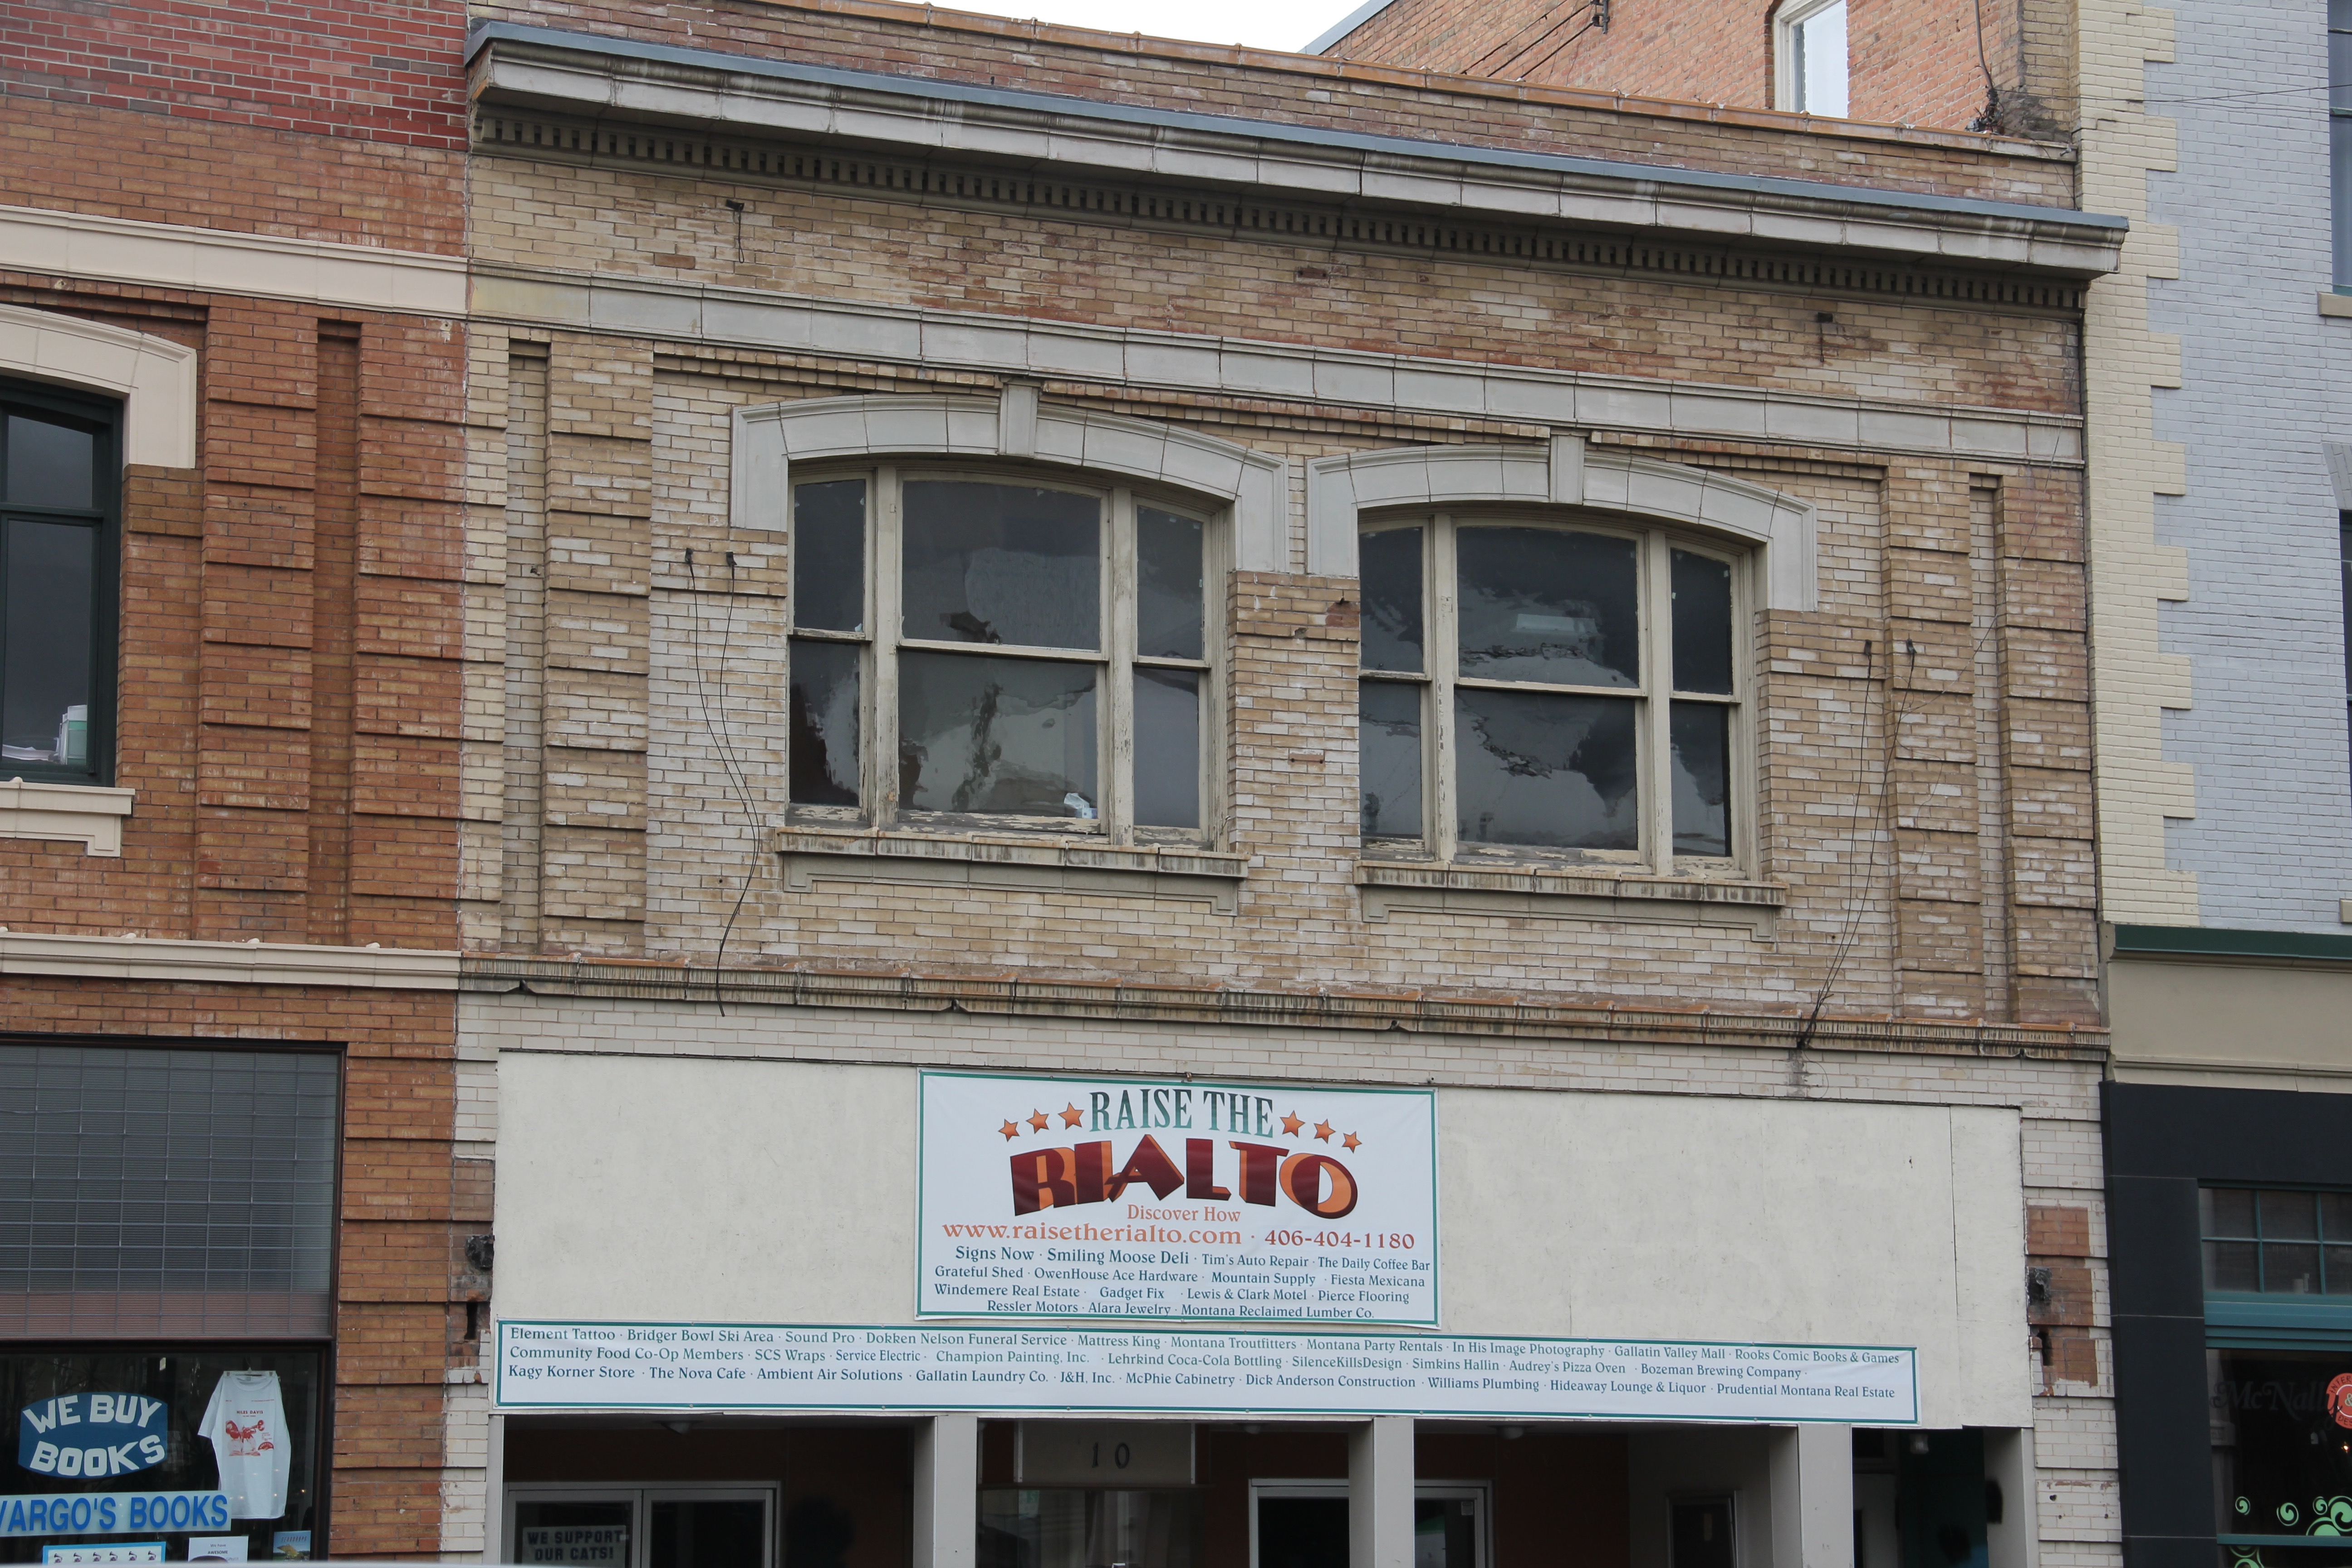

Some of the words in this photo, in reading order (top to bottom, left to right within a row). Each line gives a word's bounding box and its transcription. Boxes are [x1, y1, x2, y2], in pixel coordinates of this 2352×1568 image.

[1089, 1088, 1192, 1132] RAISE
[1204, 1091, 1273, 1138] THE
[1010, 1134, 1358, 1219] RIALTO
[1127, 1204, 1199, 1221] Discover
[1204, 1206, 1241, 1222] How
[942, 1222, 1241, 1244] www.raisetherialto.com
[1264, 1230, 1415, 1250] 406-404-1180
[955, 1245, 996, 1263] Signs
[1001, 1246, 1034, 1260] Now
[1047, 1248, 1105, 1266] Smiling
[1109, 1249, 1156, 1264] Moose
[1160, 1250, 1189, 1264] Deli
[1202, 1253, 1234, 1265] Tim's
[1237, 1255, 1266, 1266] Auto
[1269, 1255, 1309, 1269] Repair
[1318, 1256, 1338, 1268] The
[1342, 1257, 1370, 1271] Daily
[1373, 1258, 1408, 1270] Coffee
[1411, 1259, 1431, 1271] Bar
[935, 1265, 988, 1278] Grateful
[991, 1266, 1023, 1278] Shed
[1034, 1267, 1109, 1280] OwenHouse
[1112, 1269, 1135, 1281] Ace
[1139, 1269, 1198, 1282] Hardware
[1211, 1271, 1270, 1284] Mountain
[1274, 1272, 1316, 1287] Supply
[1331, 1274, 1365, 1285] Fiesta
[1368, 1274, 1425, 1287] Mexicana
[934, 1283, 1008, 1296] Windemere
[1012, 1284, 1039, 1296] Real
[1043, 1285, 1080, 1297] Estate
[1099, 1286, 1143, 1301] Gadget
[1147, 1287, 1164, 1299] Fix
[1187, 1288, 1221, 1299] Lewis
[1224, 1288, 1234, 1300] &
[1237, 1288, 1270, 1300] Clark
[1273, 1289, 1307, 1300] Motel
[1318, 1290, 1355, 1301] Pierce
[1358, 1290, 1409, 1305] Flooring
[987, 1300, 1032, 1312] Ressler
[1035, 1301, 1078, 1313] Motors
[1088, 1302, 1121, 1313] Alara
[1125, 1302, 1171, 1317] Jewelry
[1181, 1304, 1235, 1316] Montana
[1239, 1305, 1303, 1317] Reclaimed
[1306, 1306, 1352, 1318] Lumber
[1356, 1307, 1374, 1318] Co.
[510, 1327, 568, 1340] Element
[572, 1328, 616, 1340] Tattoo
[627, 1328, 677, 1344] Bridger
[681, 1329, 714, 1342] Bowl
[718, 1330, 740, 1342] Ski
[743, 1330, 774, 1343] Area
[785, 1331, 828, 1343] Sound
[832, 1331, 855, 1343] Pro
[866, 1332, 916, 1344] Dokken
[921, 1333, 964, 1344] Nelson
[968, 1333, 1017, 1345] Funeral
[1021, 1333, 1067, 1346] Service
[1078, 1334, 1129, 1347] Mattress
[1132, 1335, 1160, 1350] King
[1171, 1336, 1225, 1348] Montana
[1228, 1337, 1297, 1349] Troutfitters
[1307, 1338, 1360, 1351] Montana
[1364, 1339, 1396, 1353] Party
[1399, 1340, 1443, 1352] Rentals
[1453, 1341, 1465, 1352] In
[1468, 1342, 1487, 1353] His
[1490, 1342, 1526, 1357] Image
[1529, 1343, 1605, 1358] Photography
[1614, 1345, 1661, 1357] Gallatin
[1663, 1347, 1698, 1361] Valley
[1701, 1348, 1725, 1359] Mall
[1735, 1348, 1770, 1360] Rooks
[1773, 1349, 1809, 1361] Comic
[1813, 1351, 1847, 1362] Books
[1850, 1352, 1859, 1362] &
[1862, 1352, 1899, 1363] Games
[510, 1346, 593, 1362] Community
[597, 1347, 631, 1359] Food
[635, 1348, 679, 1362] Co-Op
[683, 1348, 744, 1360] Members
[755, 1348, 781, 1361] SCS
[784, 1349, 826, 1364] Wraps
[835, 1349, 876, 1361] Service
[879, 1349, 921, 1362] Electric
[936, 1350, 1003, 1364] Champion
[1007, 1351, 1063, 1365] Painting,
[1067, 1351, 1089, 1362] Inc.
[1108, 1352, 1164, 1365] Lehrkind
[1168, 1353, 1230, 1366] Coca-Cola
[1234, 1355, 1282, 1369] Bottling
[1292, 1356, 1402, 1371] SilenceKillsDesign
[1412, 1357, 1460, 1370] Simkins
[1464, 1359, 1499, 1371] Hallin
[1509, 1360, 1559, 1374] Audrey's
[1563, 1361, 1592, 1372] Pizza
[1595, 1362, 1626, 1373] Oven
[1641, 1363, 1694, 1375] Bozeman
[1697, 1364, 1743, 1379] Brewing
[1746, 1366, 1801, 1381] Company
[509, 1364, 543, 1380] Kagy
[547, 1365, 595, 1377] Korner
[598, 1366, 635, 1378] Store
[649, 1367, 674, 1379] The
[678, 1367, 712, 1379] Nova
[716, 1367, 746, 1379] Cafe
[757, 1367, 813, 1380] Ambient
[817, 1368, 837, 1380] Air
[840, 1368, 903, 1381] Solutions
[916, 1369, 967, 1382] Gallatin
[972, 1370, 1026, 1385] Laundry
[1029, 1370, 1048, 1382] Co.
[1060, 1371, 1088, 1384] J&H,
[1092, 1372, 1115, 1383] Inc.
[1126, 1372, 1171, 1384] McPhie
[1175, 1373, 1235, 1387] Cabinetry
[1246, 1374, 1273, 1385] Dick
[1276, 1374, 1334, 1386] Anderson
[1338, 1375, 1416, 1387] Construction
[1427, 1377, 1479, 1389] Williams
[1482, 1378, 1539, 1392] Plumbing
[1550, 1380, 1607, 1394] Hideaway
[1611, 1381, 1653, 1395] Lounge
[1656, 1381, 1665, 1392] &
[1669, 1382, 1706, 1395] Liquor
[1717, 1383, 1777, 1395] Prudential
[1781, 1384, 1831, 1396] Montana
[1834, 1386, 1858, 1397] Real
[1862, 1386, 1895, 1398] Estate
[22, 1395, 81, 1434] WE
[89, 1394, 162, 1428] BUY
[2209, 1380, 2343, 1431] McNally
[29, 1435, 166, 1476] BOOKS
[130, 1494, 228, 1529] BOOKS
[527, 1531, 548, 1545] WE
[554, 1529, 623, 1544] SUPPORT
[534, 1547, 564, 1561] OUR
[570, 1546, 614, 1560] CATS!
